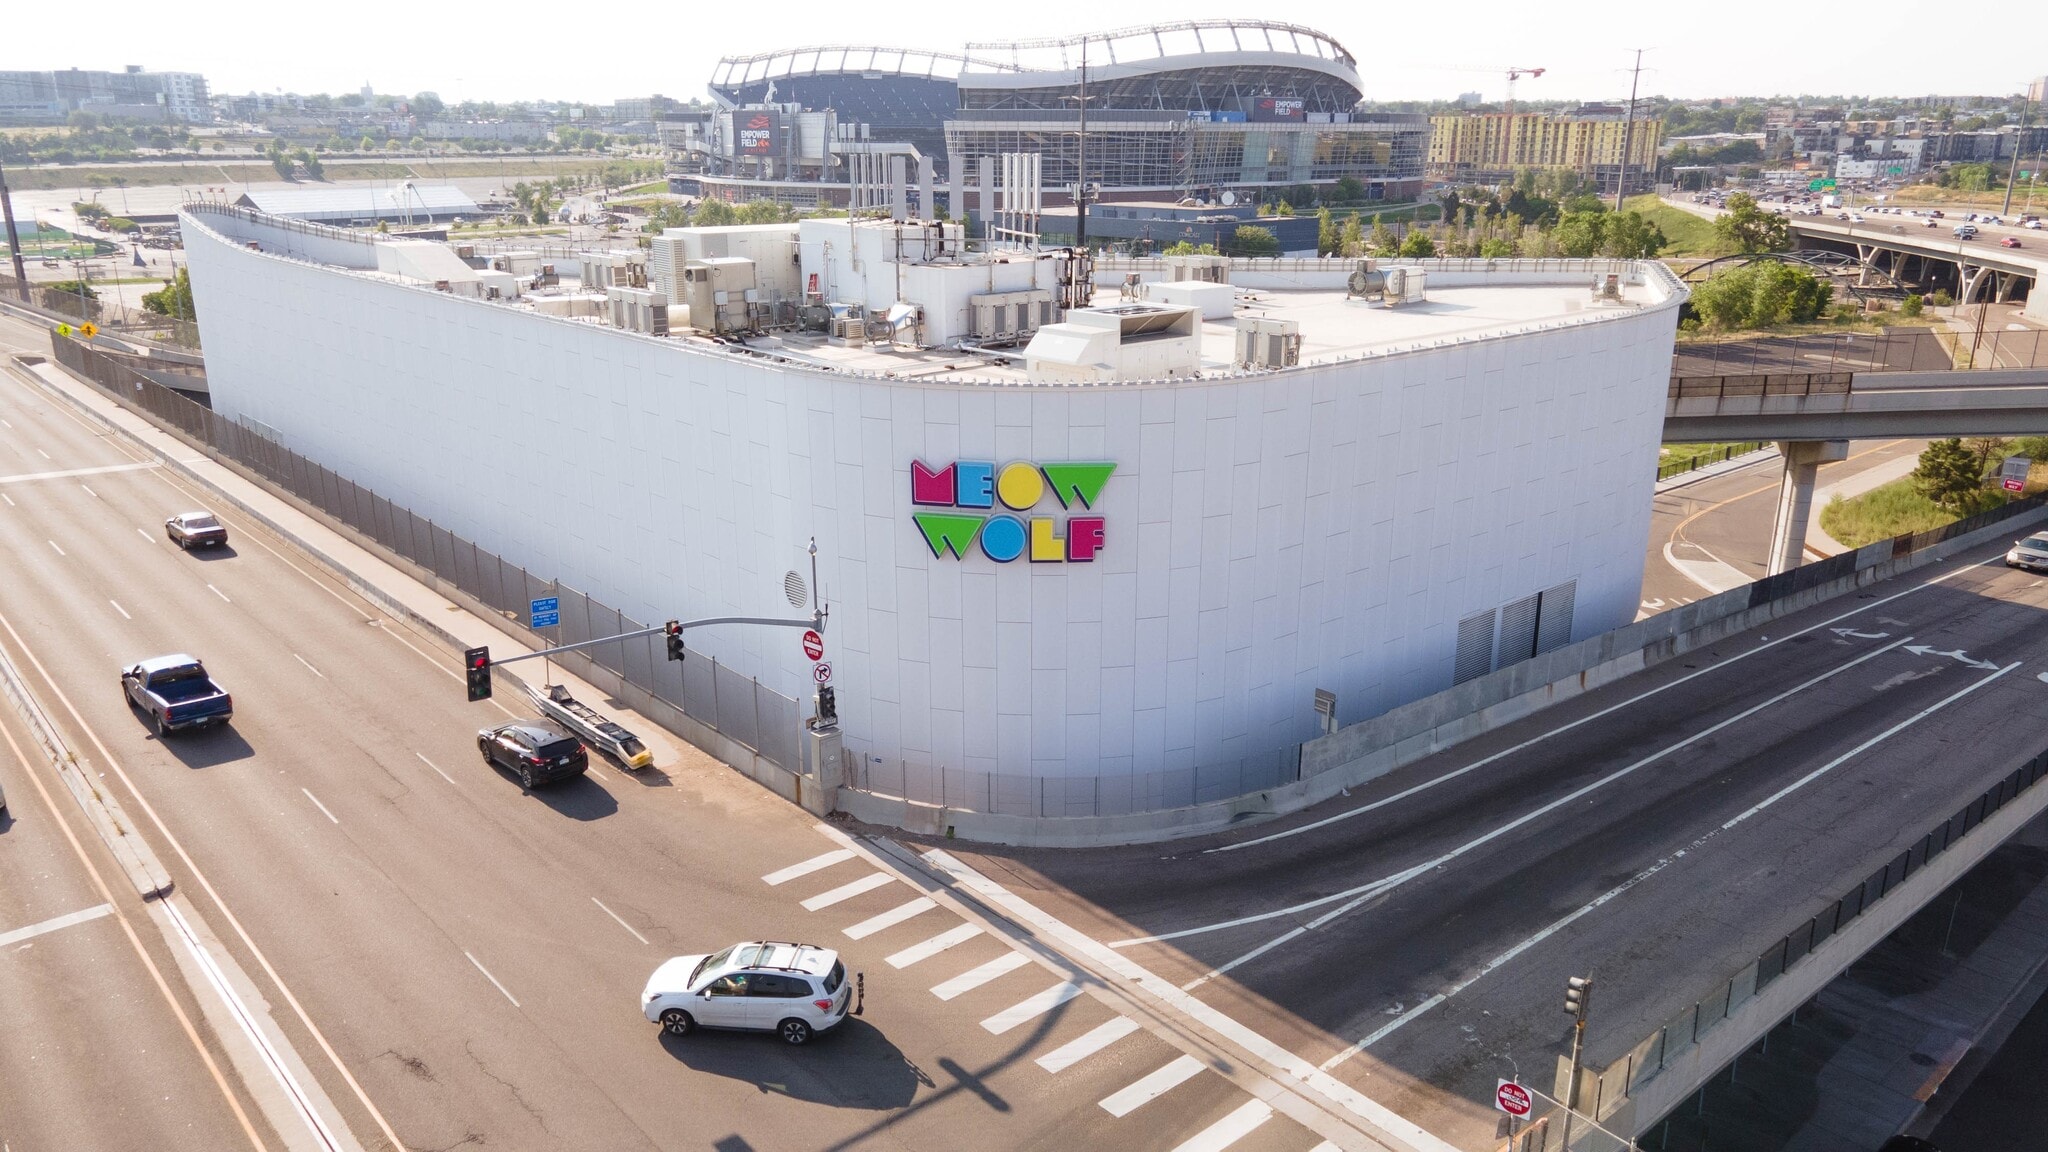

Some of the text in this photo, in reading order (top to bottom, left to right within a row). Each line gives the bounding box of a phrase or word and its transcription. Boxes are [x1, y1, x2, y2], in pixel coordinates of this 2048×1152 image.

[1275, 100, 1302, 109] EMPOWER
[1275, 108, 1290, 116] FIELD
[741, 130, 770, 139] EMPOWER
[741, 139, 757, 147] FIELD
[911, 459, 1118, 511] MEOW
[912, 511, 1105, 563] WOLF
[1504, 1086, 1513, 1094] DO
[1513, 1090, 1525, 1099] NOT
[1504, 1099, 1522, 1111] ENTER
